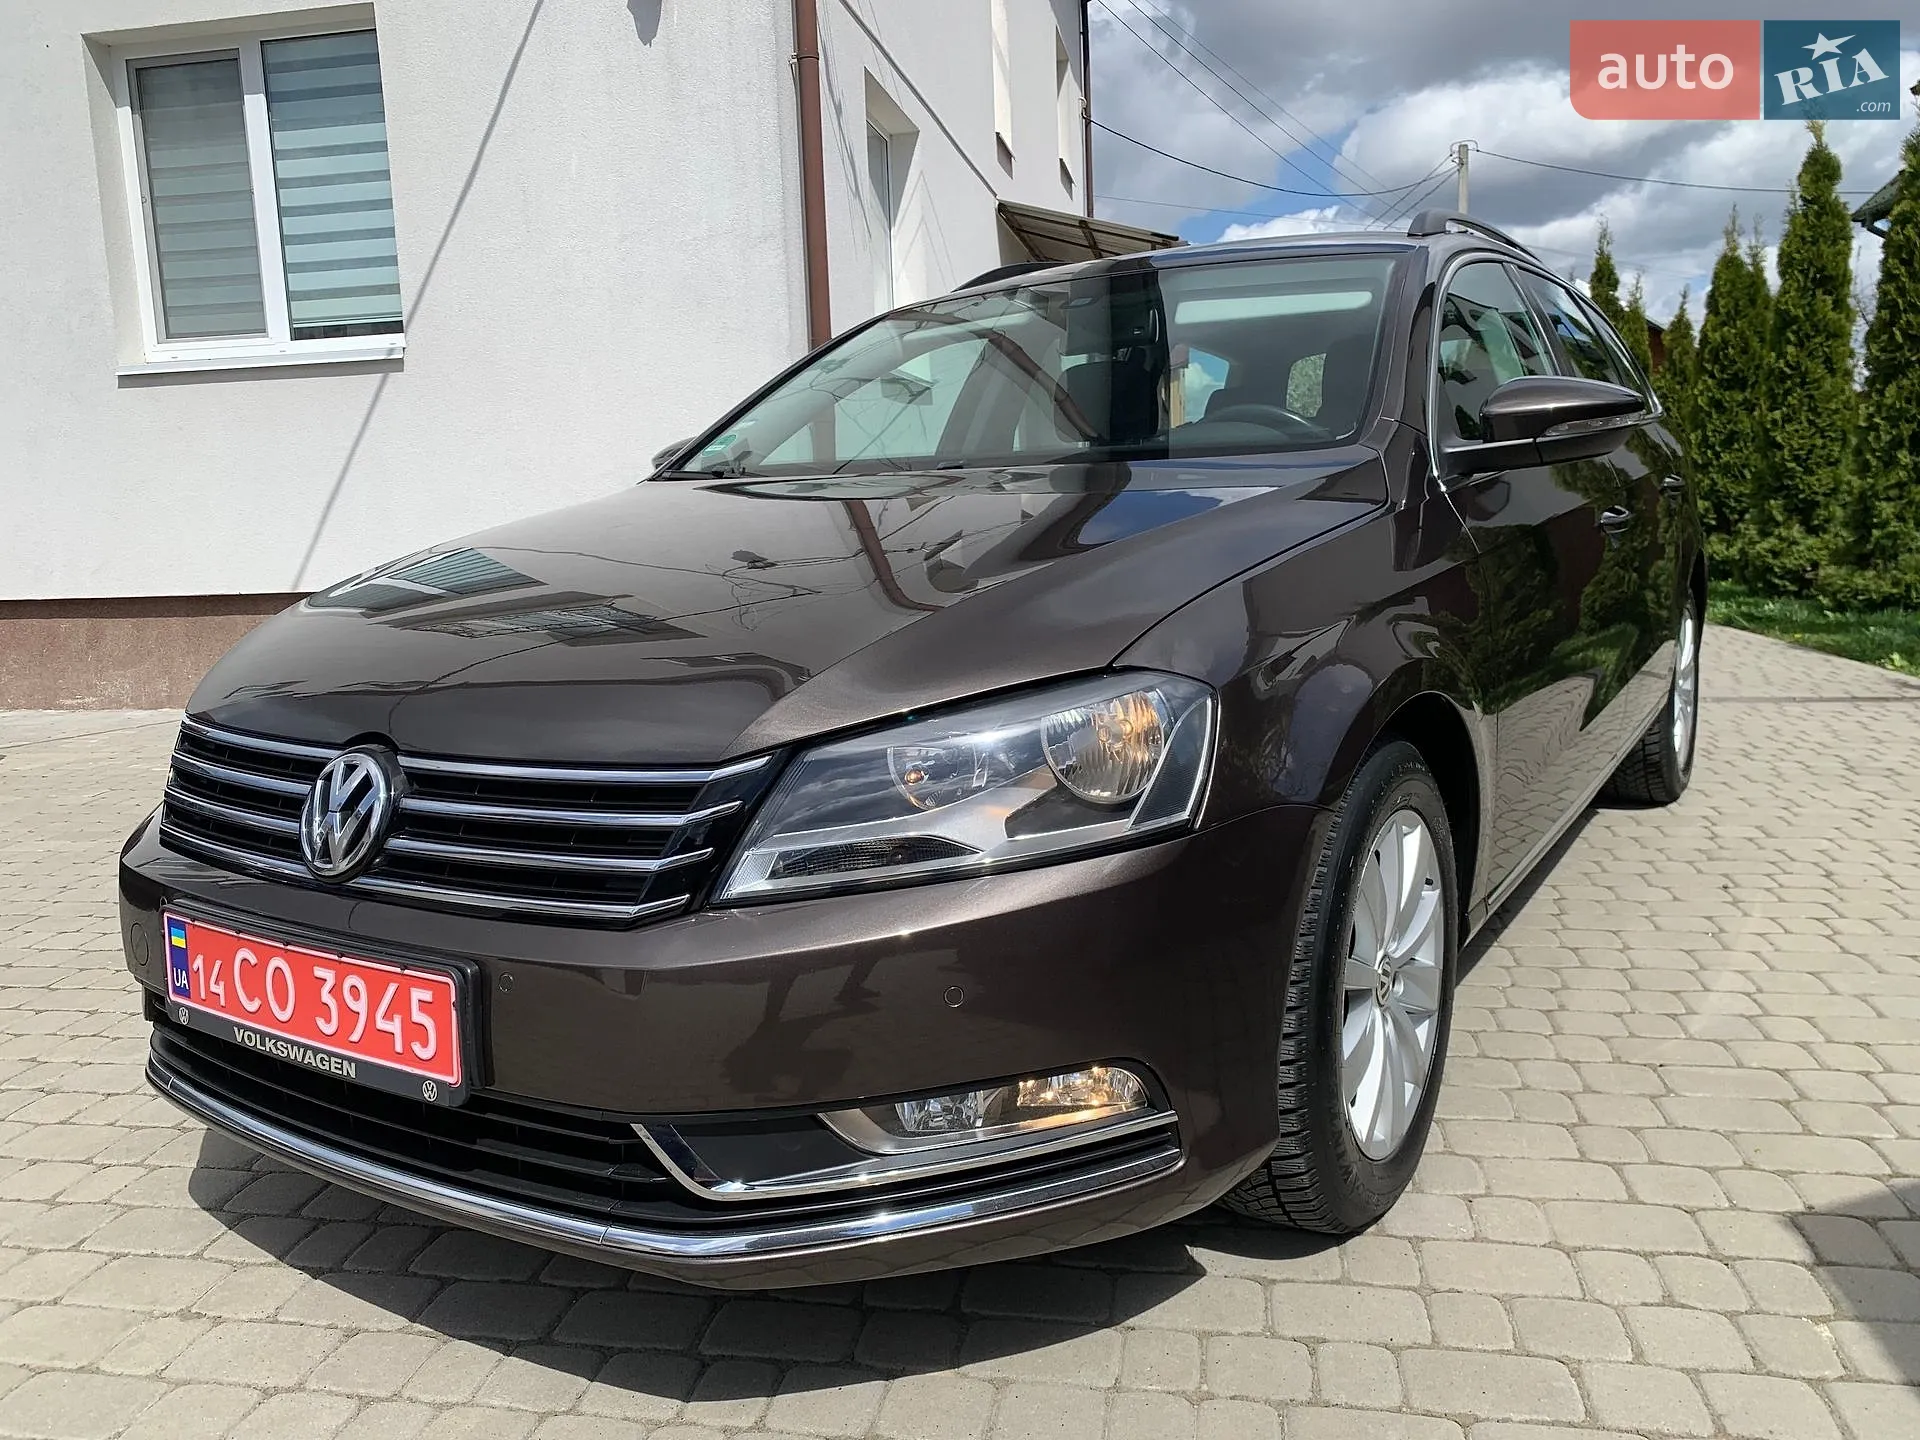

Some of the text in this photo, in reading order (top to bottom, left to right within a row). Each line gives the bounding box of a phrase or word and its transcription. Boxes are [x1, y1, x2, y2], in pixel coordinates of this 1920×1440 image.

[173, 967, 190, 990] UA
[313, 966, 437, 1061] 3945
[233, 1026, 357, 1079] VOLKSWAGEN
